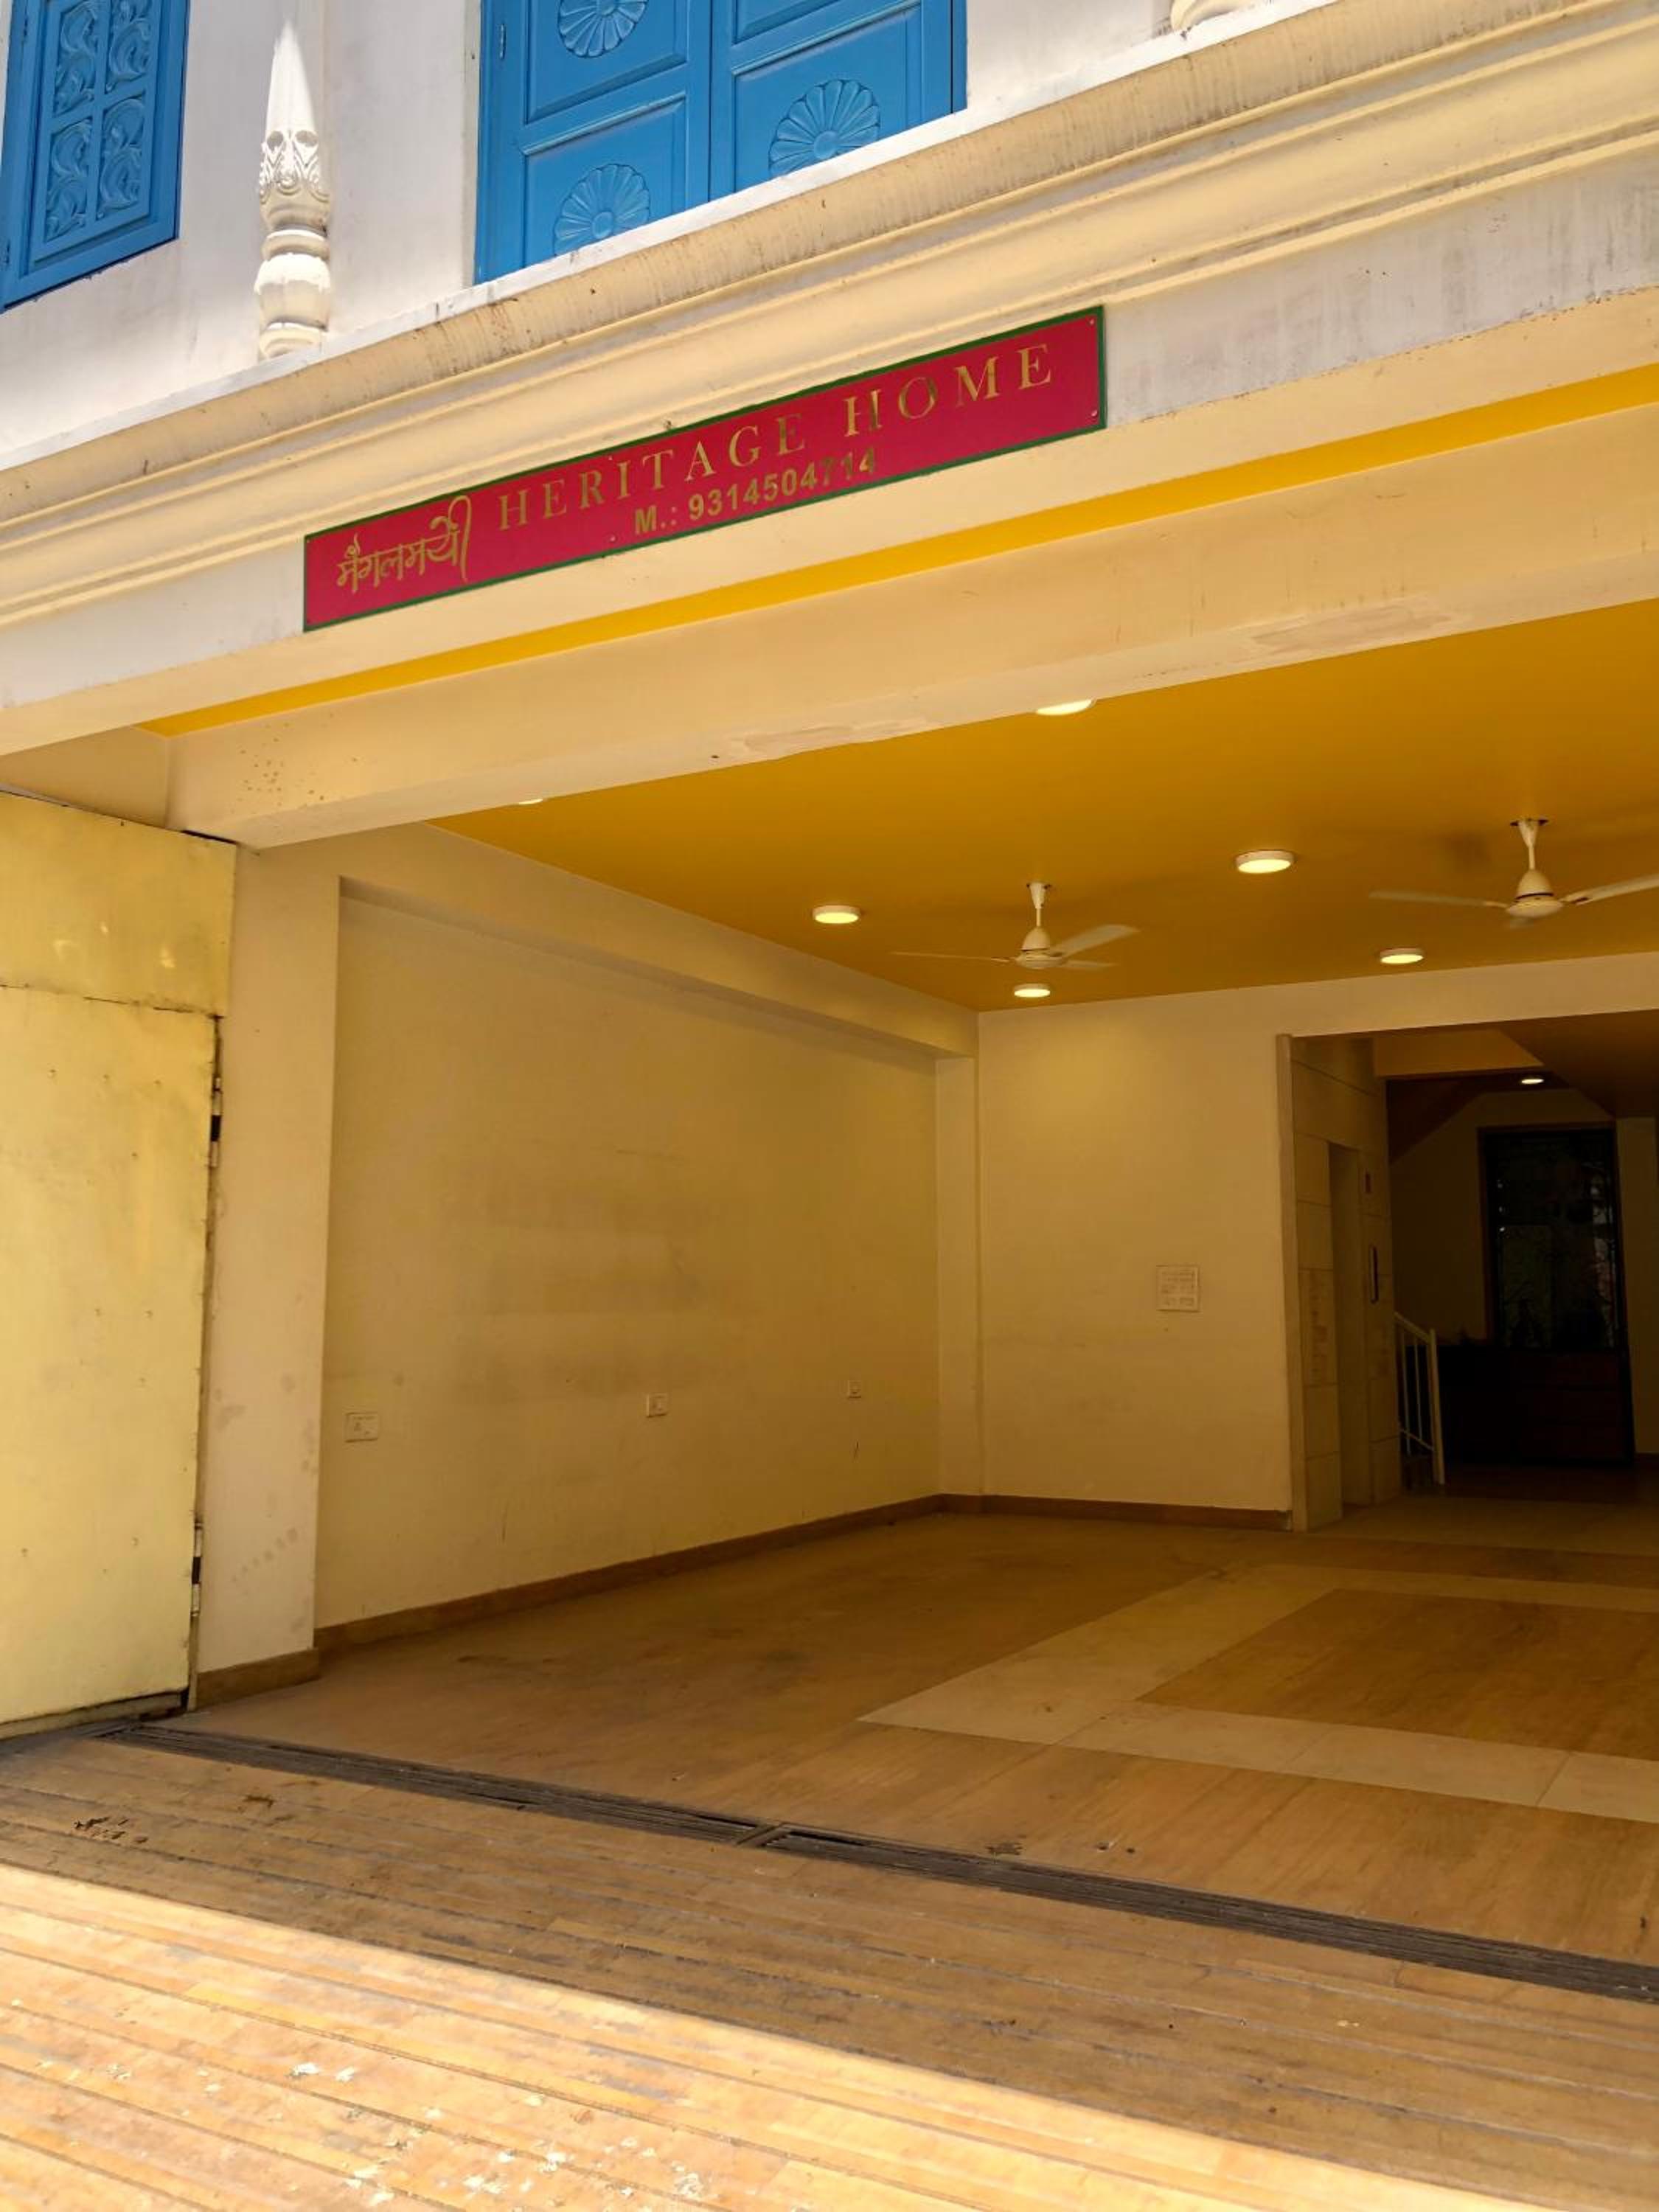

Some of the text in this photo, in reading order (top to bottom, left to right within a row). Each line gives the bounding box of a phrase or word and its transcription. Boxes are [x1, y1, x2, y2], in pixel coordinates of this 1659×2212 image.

[497, 344, 1052, 530] HERITAGE HOME
[689, 447, 876, 521] 9314504714
